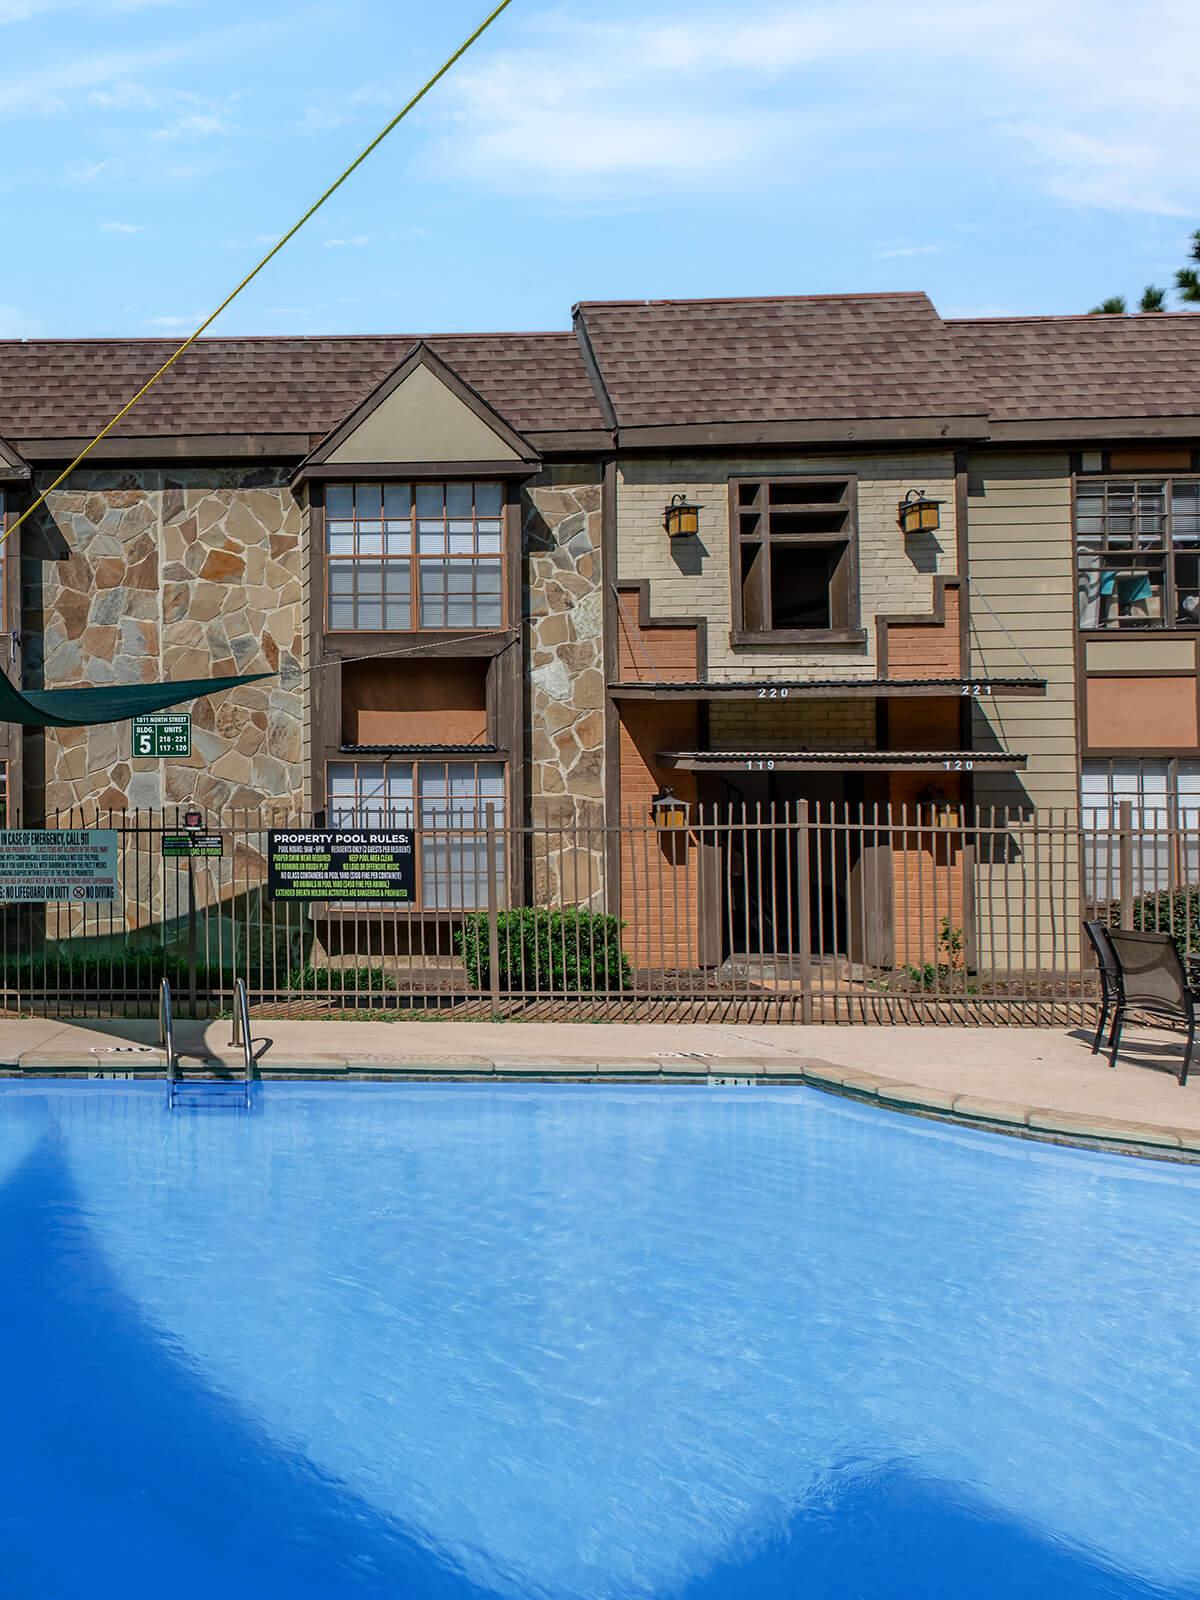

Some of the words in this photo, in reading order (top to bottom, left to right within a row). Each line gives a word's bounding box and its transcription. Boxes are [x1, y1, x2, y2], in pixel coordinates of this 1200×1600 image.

[758, 688, 788, 698] 220
[962, 685, 991, 695] 221
[140, 735, 151, 754] 5
[746, 760, 775, 770] 119
[943, 760, 973, 770] 120
[0, 832, 7, 846] IN
[8, 832, 22, 846] CASE
[23, 832, 30, 846] OF
[31, 832, 65, 847] EMERGENCY,
[66, 832, 80, 846] CALL
[81, 832, 89, 846] 911
[274, 834, 333, 843] PROPERTY
[336, 834, 367, 843] POOL
[370, 834, 409, 843] RULES:
[6, 886, 14, 898] NO
[15, 886, 45, 898] LIFEGUARD
[46, 886, 54, 898] ON
[55, 886, 69, 898] DUTY
[86, 886, 94, 898] NO
[95, 886, 114, 898] DIVING
